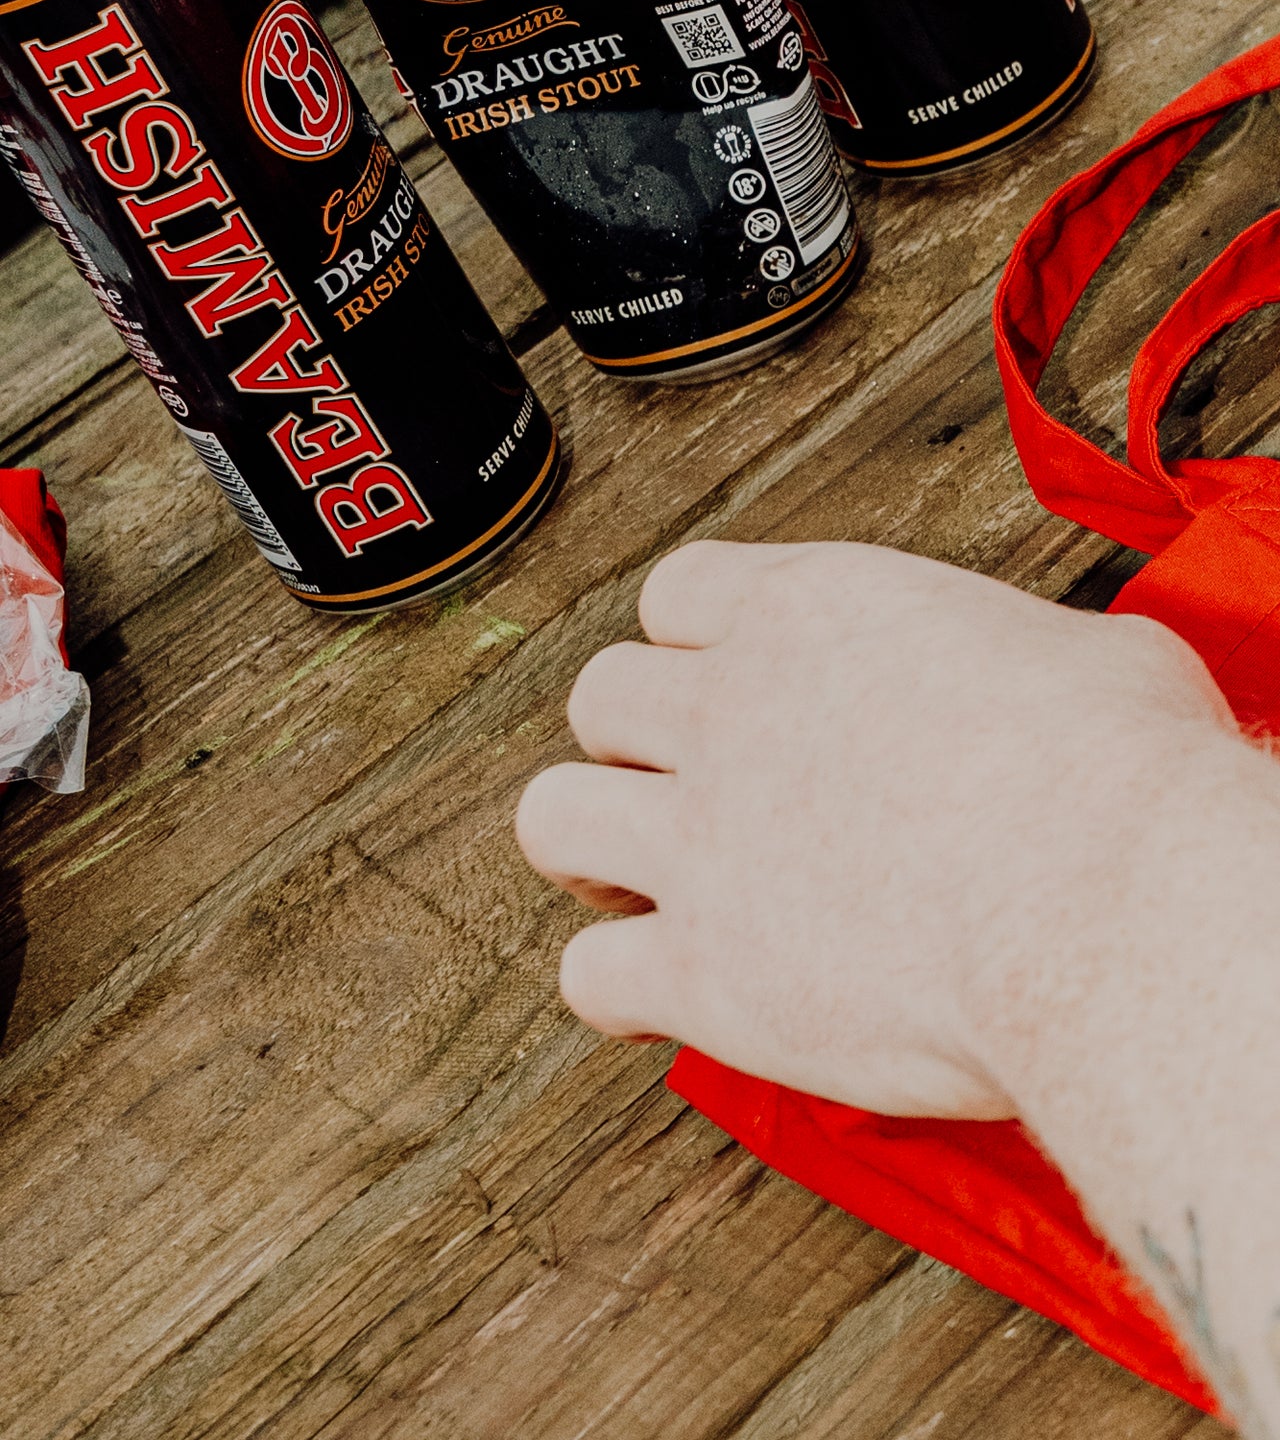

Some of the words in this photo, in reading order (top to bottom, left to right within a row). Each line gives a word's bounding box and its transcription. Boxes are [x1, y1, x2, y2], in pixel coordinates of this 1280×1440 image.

[654, 3, 674, 15] BEST
[745, 15, 765, 32] SCAN
[761, 20, 772, 33] OR
[440, 5, 580, 76] Genuine
[431, 33, 626, 109] DRAUGHT
[908, 96, 959, 125] SERVE
[963, 61, 1023, 104] CHILLED
[444, 95, 536, 140] IRISH
[538, 64, 641, 113] STOUT
[702, 104, 723, 116] Help
[723, 99, 735, 110] us
[735, 176, 758, 198] 18+
[314, 169, 415, 304] DRAUGH
[20, 3, 435, 559] BEAMISH
[334, 255, 409, 332] IRISH
[405, 213, 430, 264] STO
[571, 306, 614, 325] SERVE
[619, 288, 683, 319] CHILLED
[478, 434, 516, 482] SERVE
